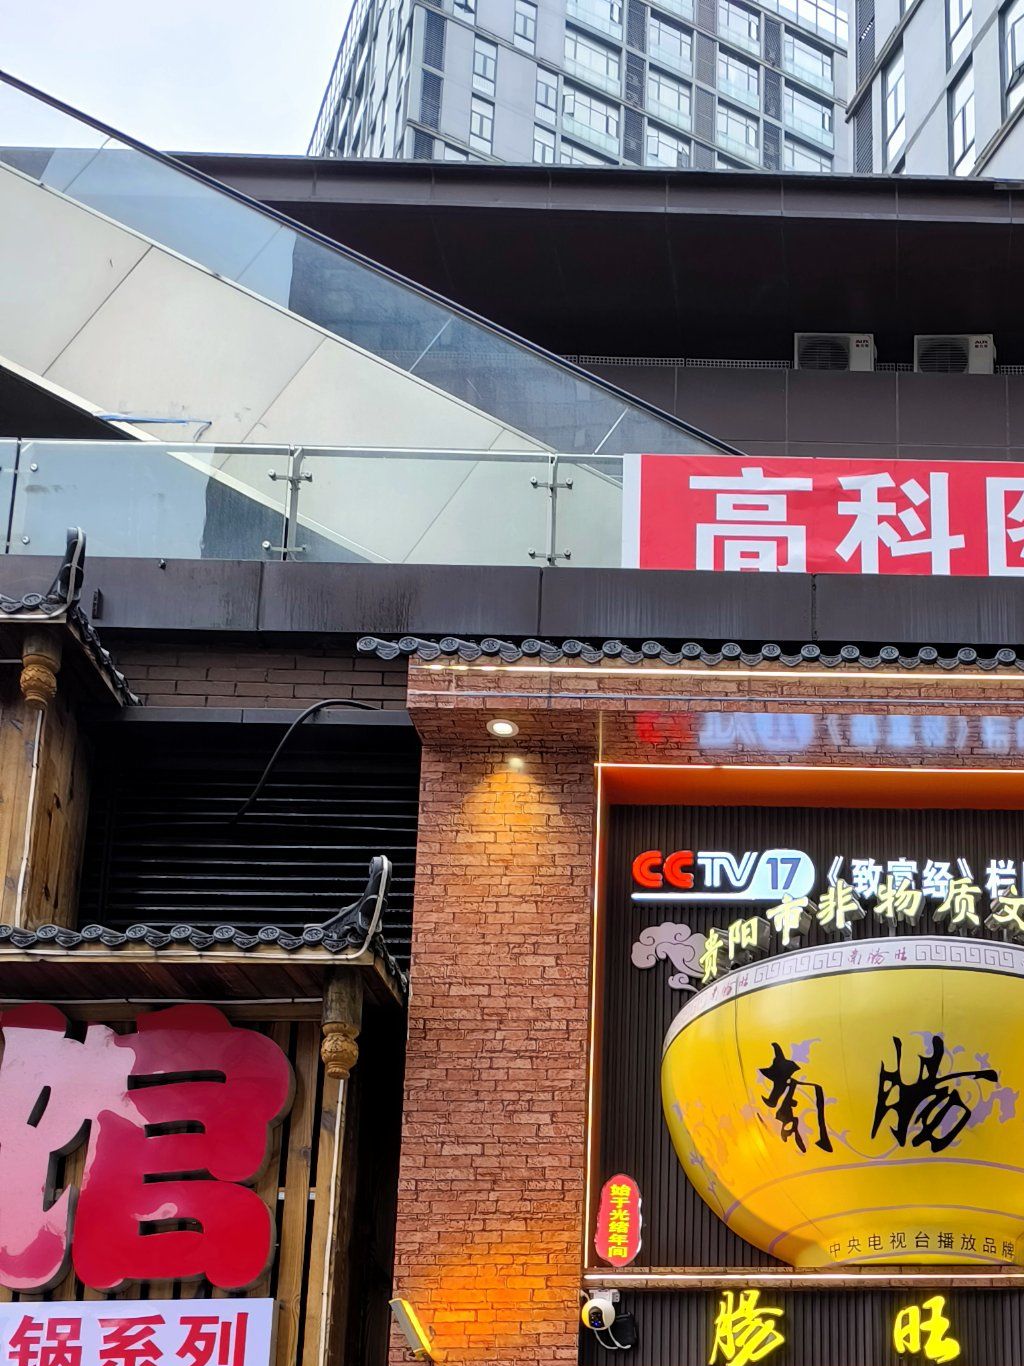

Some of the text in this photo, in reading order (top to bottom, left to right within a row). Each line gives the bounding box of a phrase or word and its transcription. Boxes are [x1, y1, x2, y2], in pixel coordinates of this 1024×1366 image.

[828, 1231, 1016, 1259] 中央电视台播放品牌
